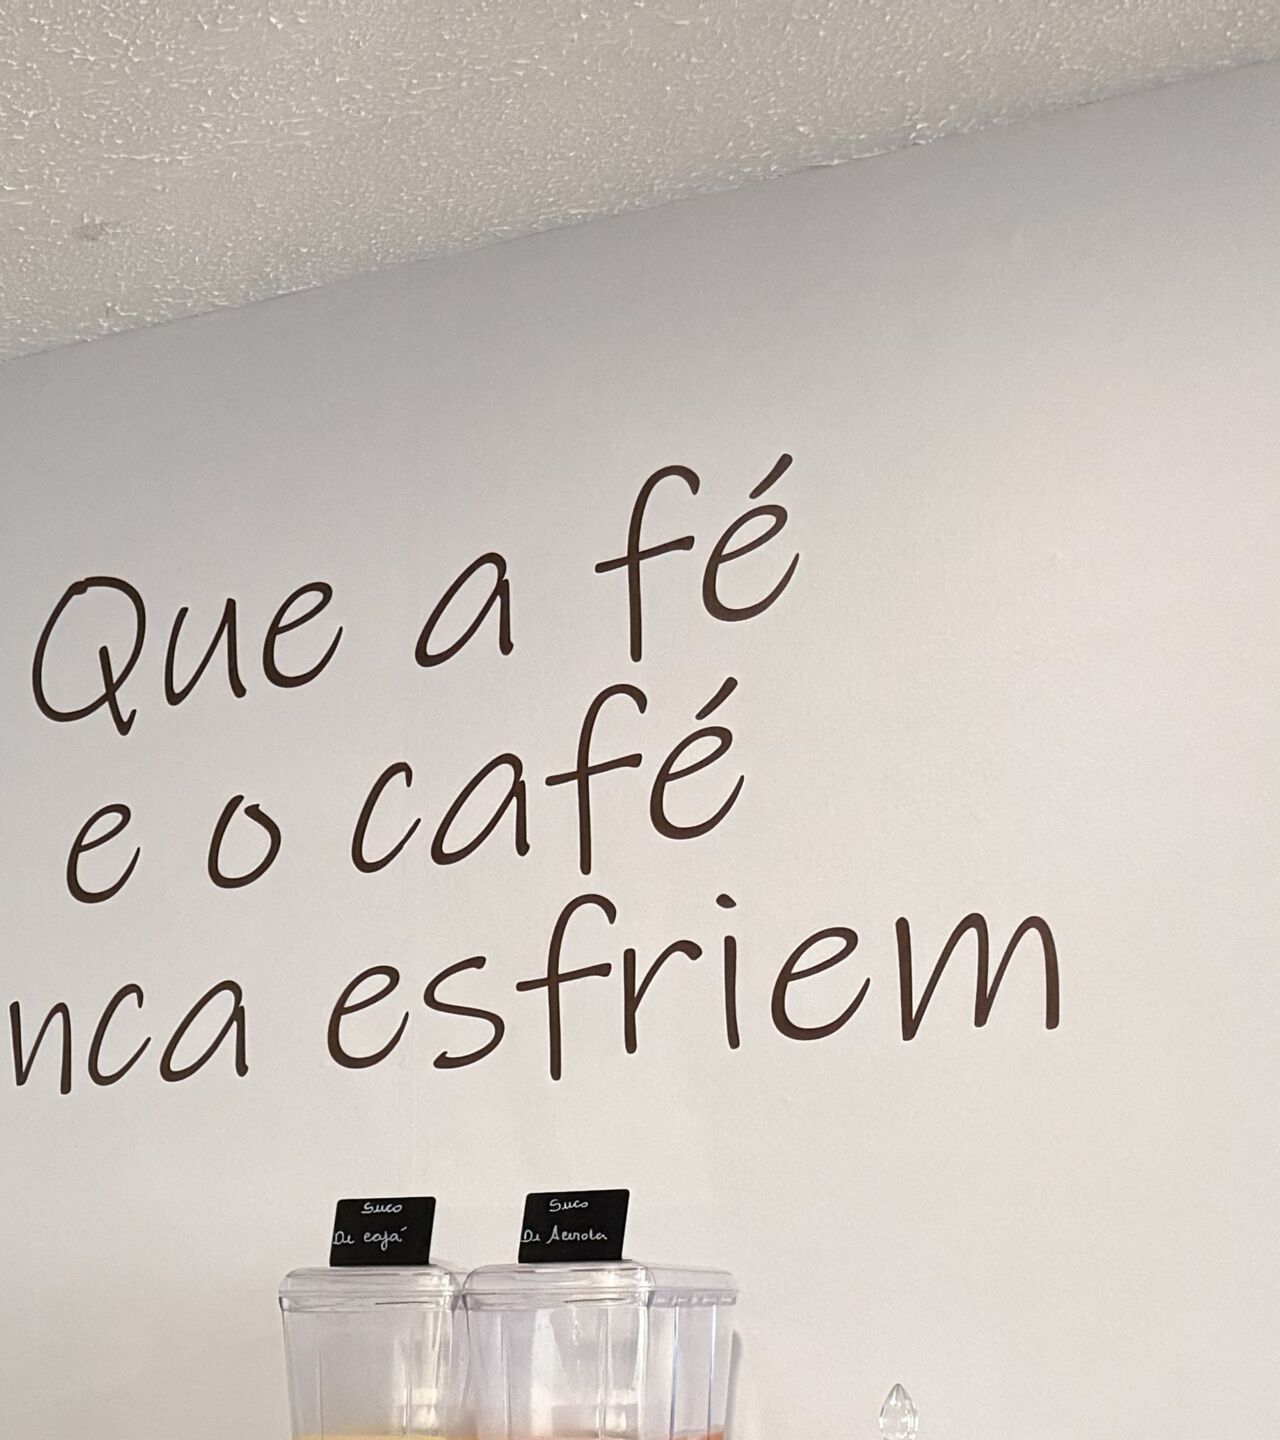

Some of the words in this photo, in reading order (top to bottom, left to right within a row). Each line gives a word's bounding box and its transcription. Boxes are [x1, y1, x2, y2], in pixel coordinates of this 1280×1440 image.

[32, 575, 344, 737] Que
[414, 551, 514, 668] a
[594, 453, 800, 663] fé
[66, 803, 141, 904] e
[207, 794, 282, 889] o
[351, 676, 745, 876] café
[327, 893, 1060, 1081] esfriem
[361, 1202, 403, 1214] Suco
[549, 1198, 589, 1212] Suco
